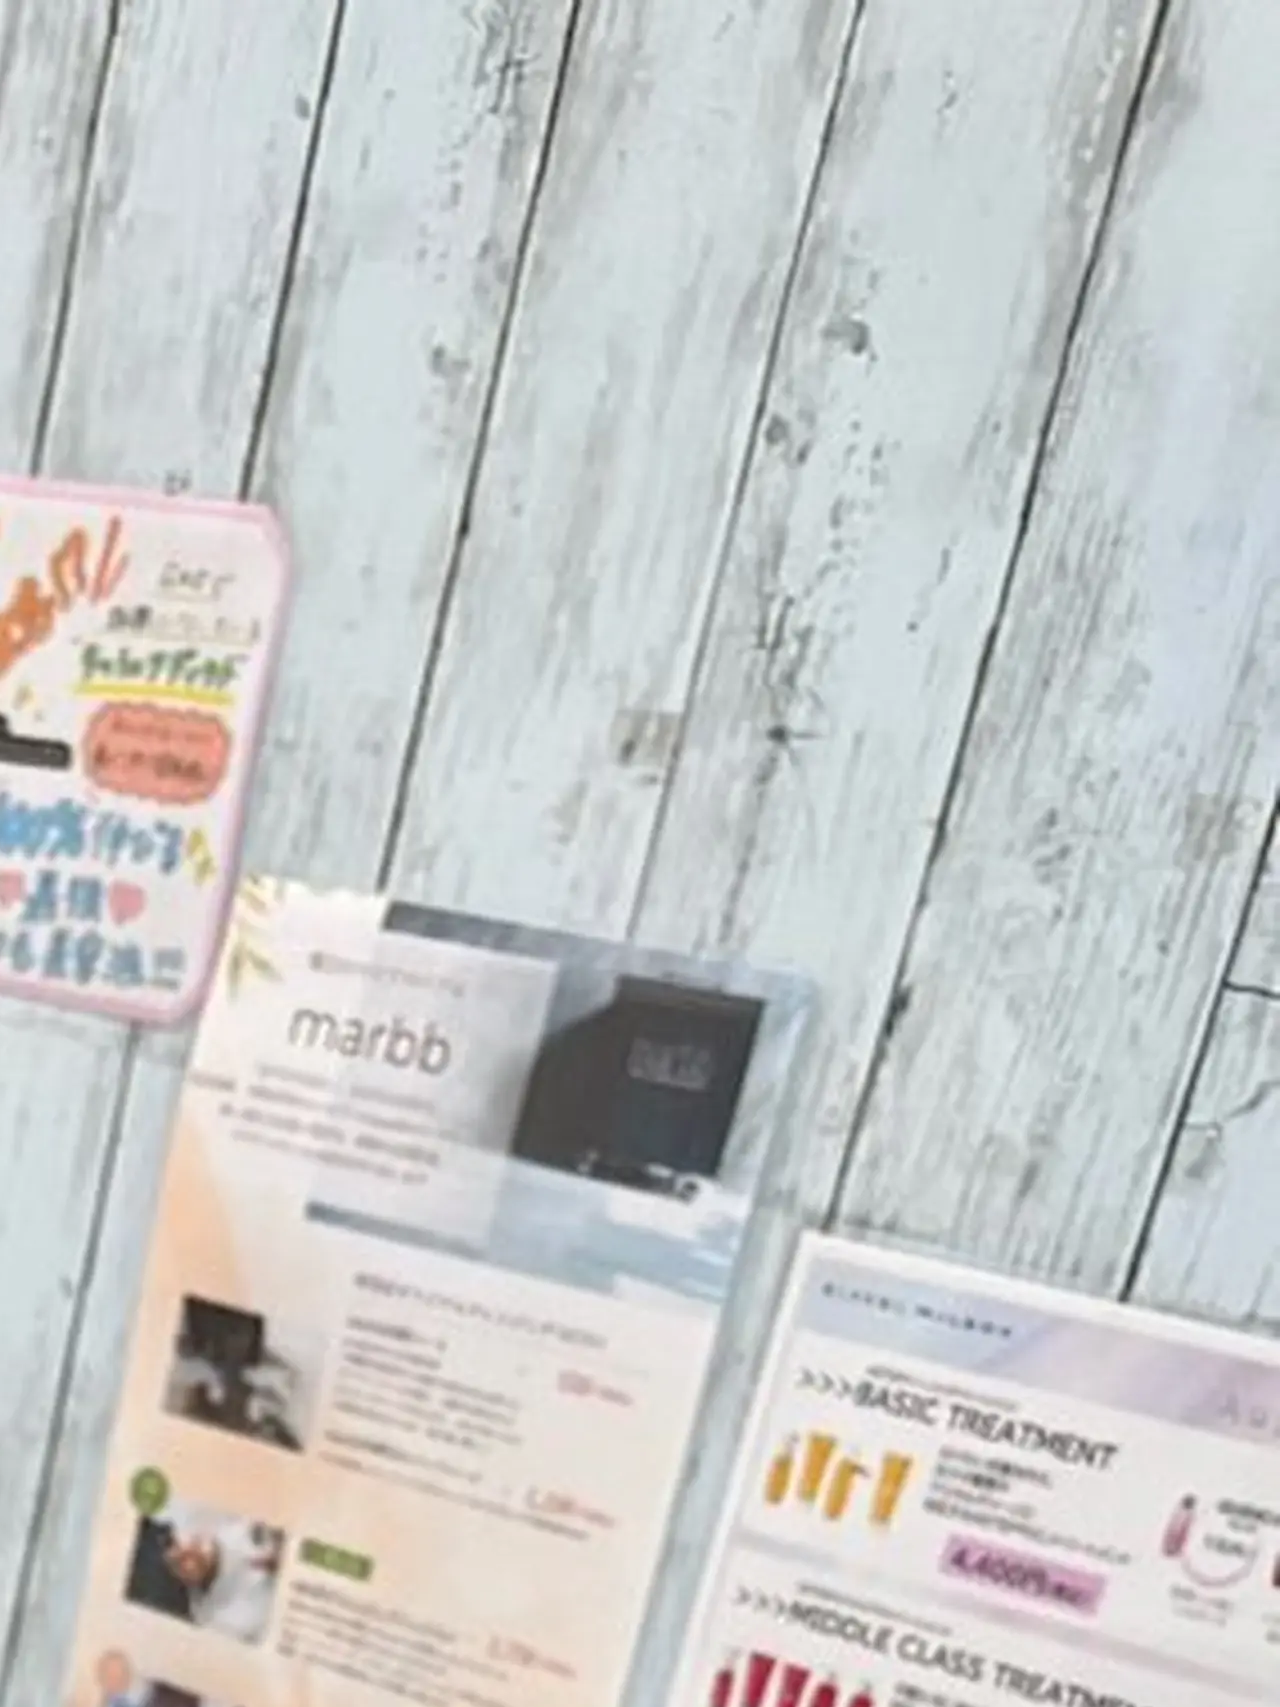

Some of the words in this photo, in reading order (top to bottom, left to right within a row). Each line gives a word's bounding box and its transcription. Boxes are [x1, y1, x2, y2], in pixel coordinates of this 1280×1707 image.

[289, 1007, 452, 1075] marbb
[854, 1380, 939, 1427] BASIC
[949, 1405, 1119, 1470] TREATMENT
[788, 1599, 892, 1653] MIDDLE
[898, 1634, 985, 1684] CLASS
